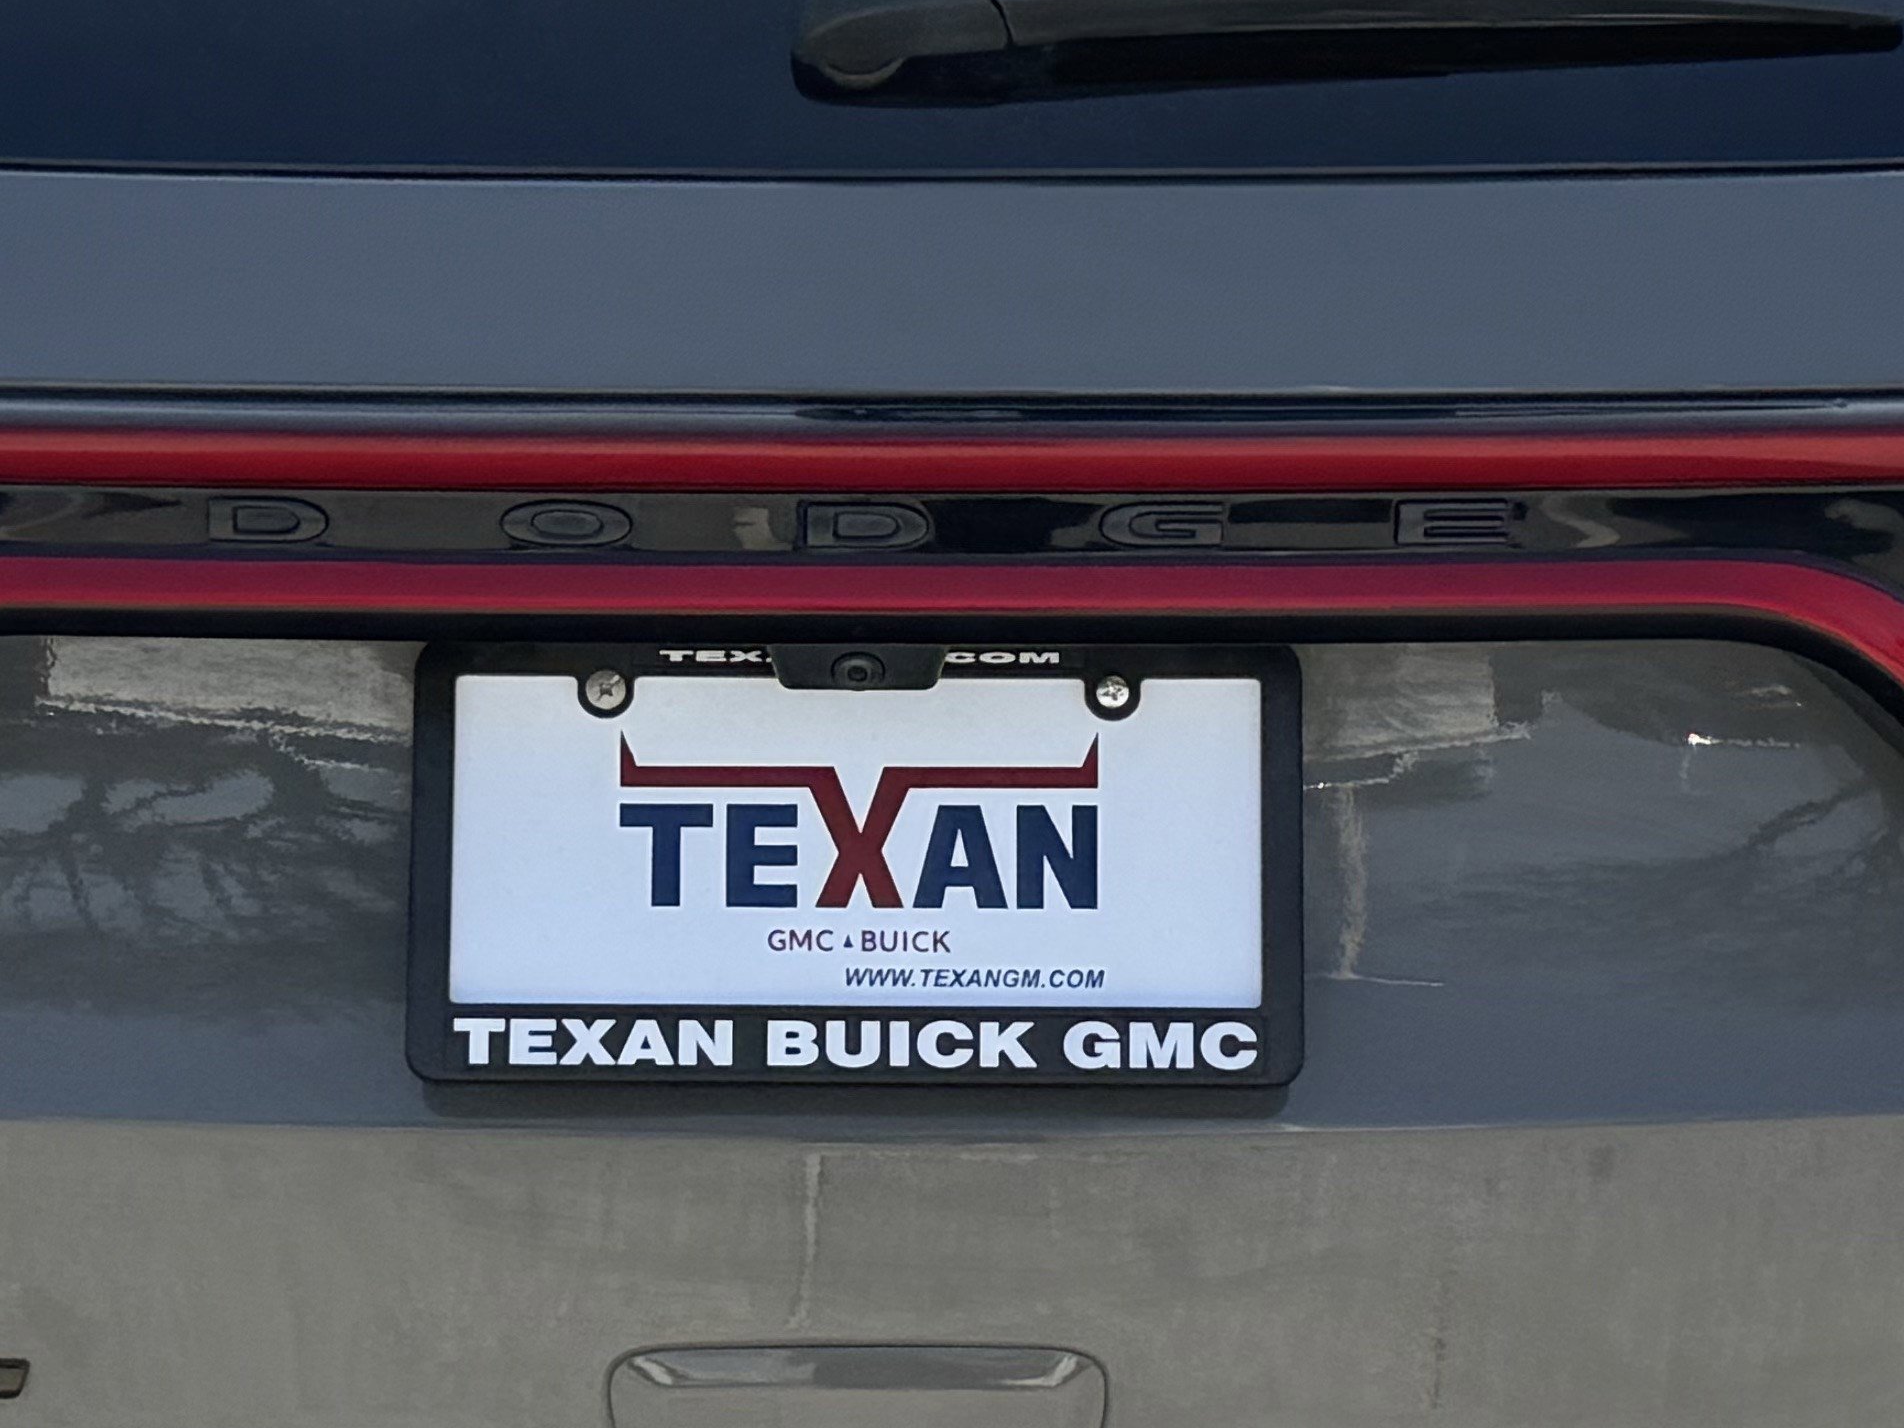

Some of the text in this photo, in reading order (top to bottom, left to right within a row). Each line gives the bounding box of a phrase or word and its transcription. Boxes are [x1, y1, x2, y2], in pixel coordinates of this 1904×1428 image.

[207, 496, 1512, 548] DODGE
[619, 730, 1098, 910] TEXAN
[767, 929, 952, 953] GMC BUICK
[845, 967, 1106, 989] WWW.TEXANGM.COM
[454, 1017, 1258, 1070] TEXAN BUICK GMC
